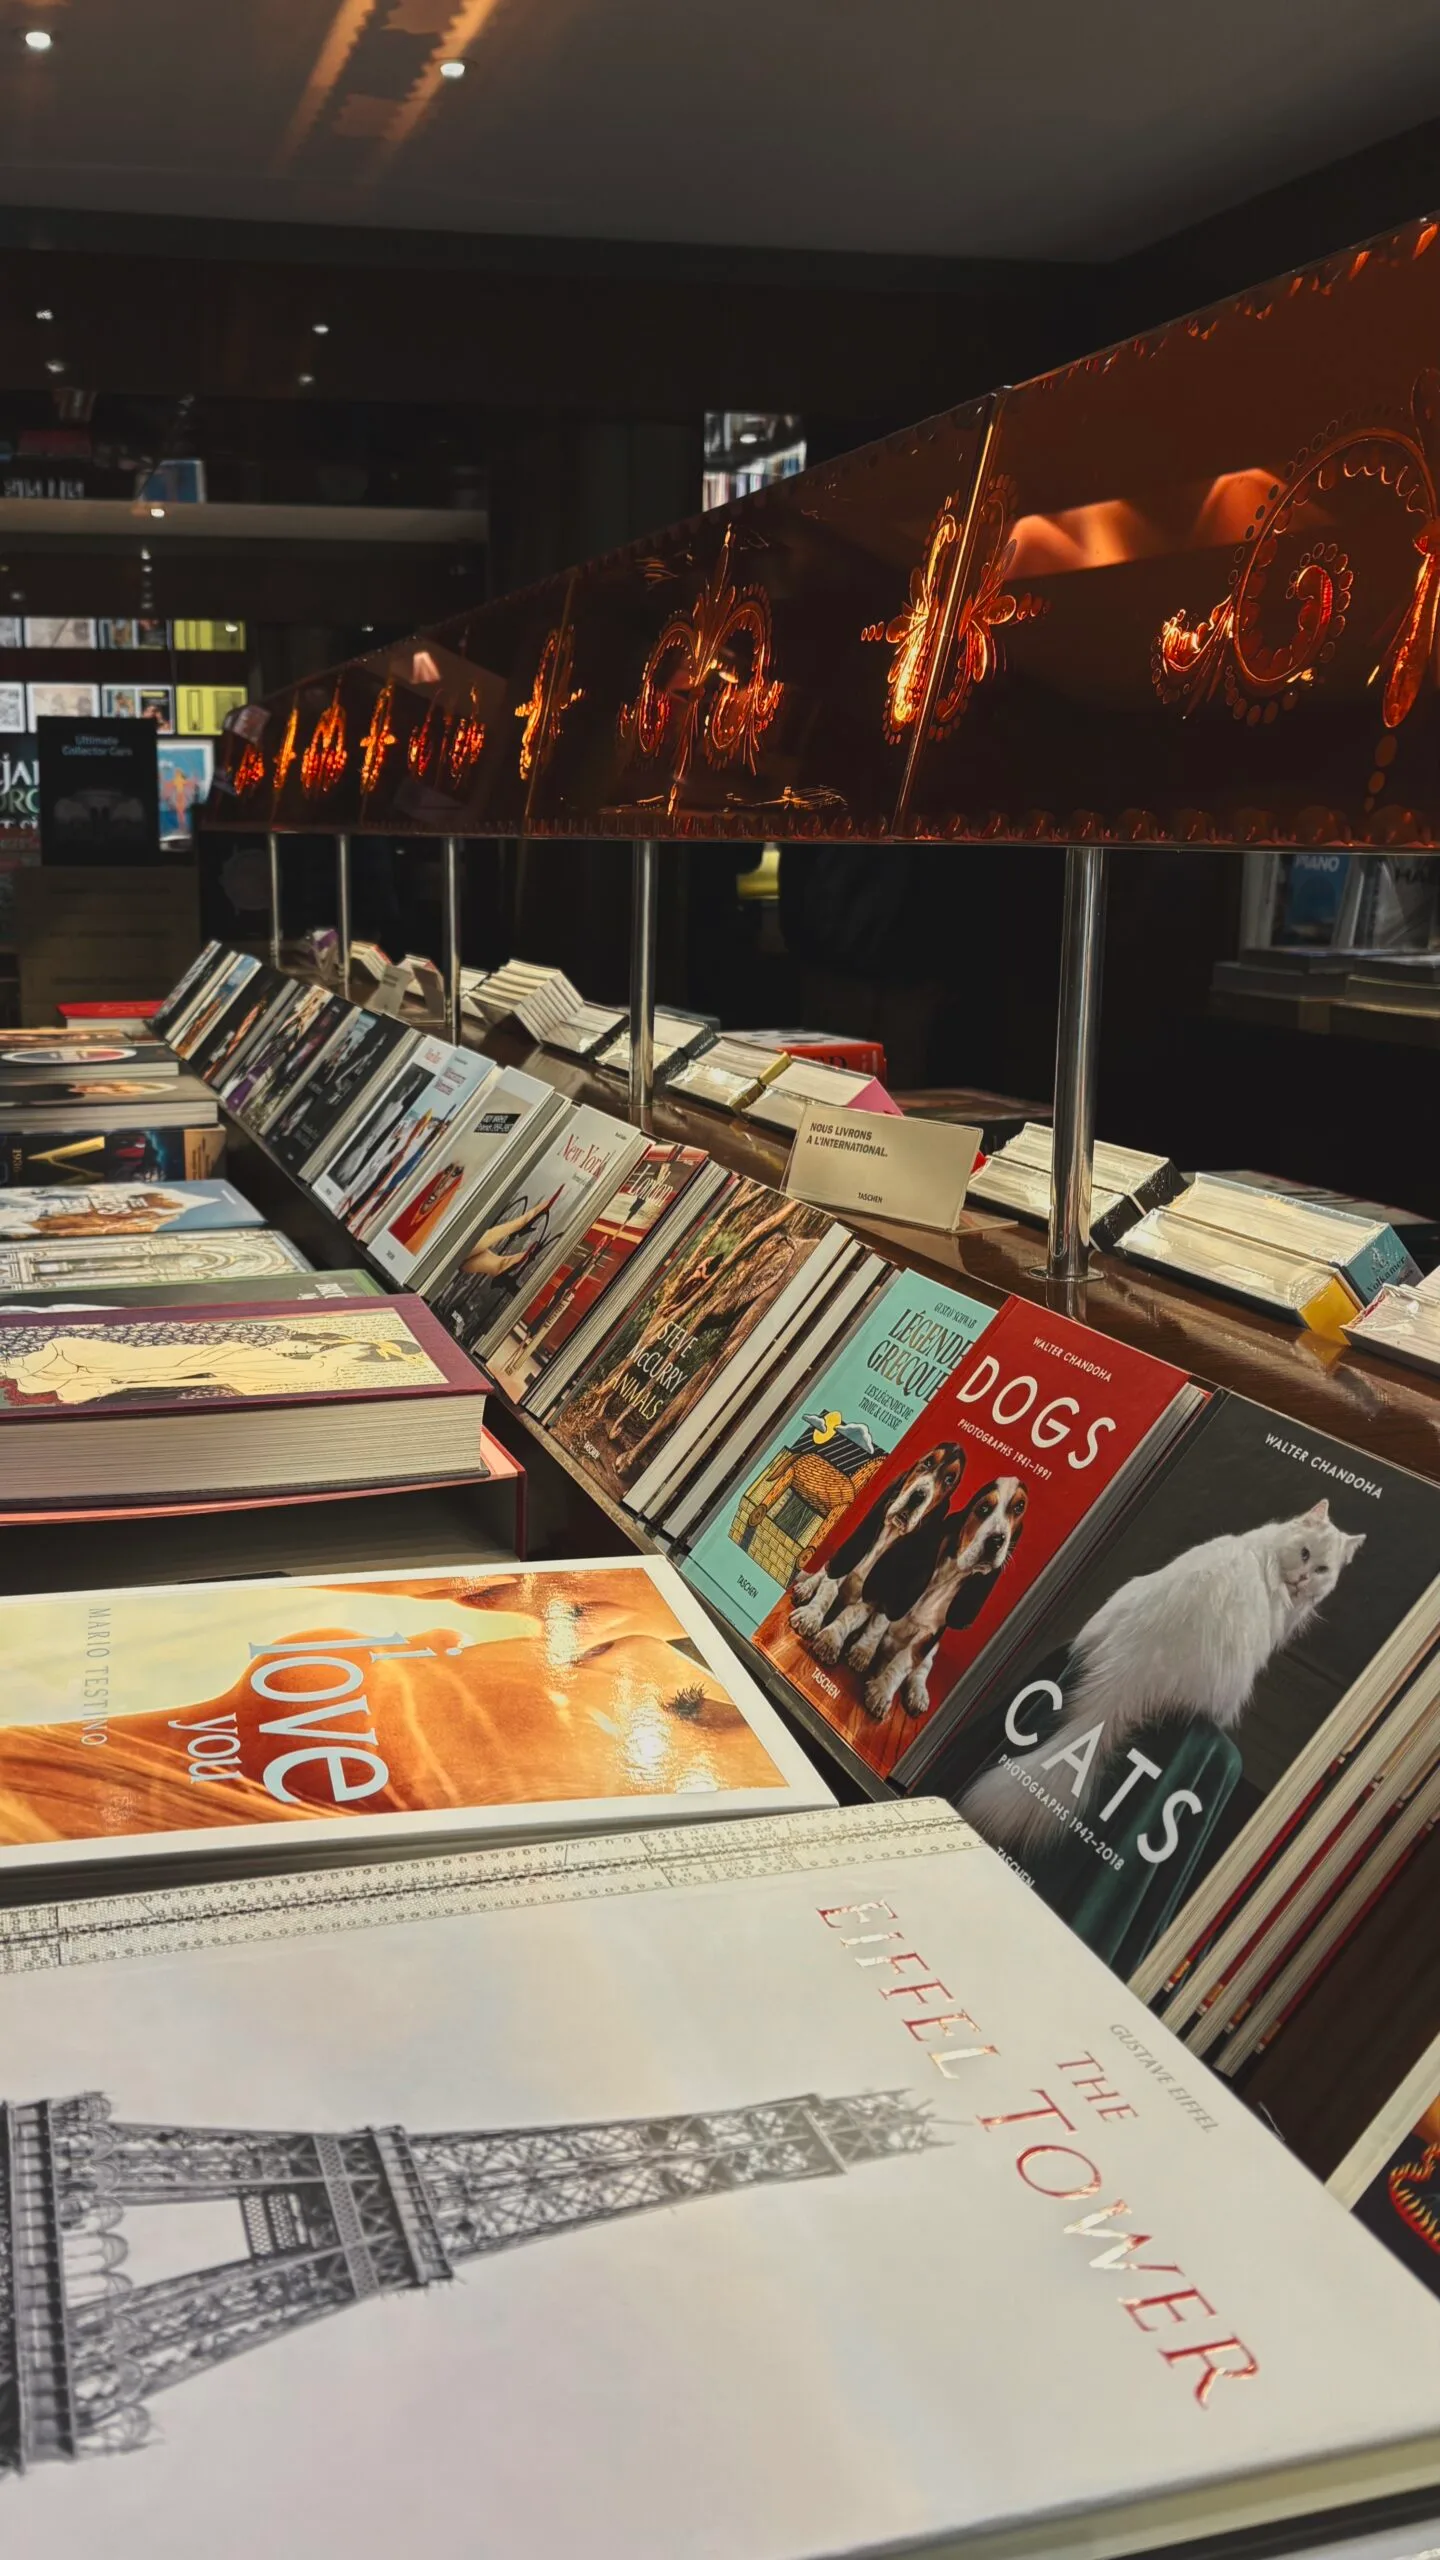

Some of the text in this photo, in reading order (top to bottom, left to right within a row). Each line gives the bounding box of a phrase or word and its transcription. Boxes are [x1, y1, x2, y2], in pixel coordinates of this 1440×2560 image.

[557, 1134, 612, 1179] New York
[809, 1122, 873, 1141] NOUS LIVRONS
[626, 1163, 674, 1208] London
[857, 1192, 883, 1204] TASCHEN
[657, 1321, 699, 1359] STEVE
[888, 1309, 976, 1371] LÉGENDE
[953, 1311, 978, 1329] SCHWAB
[627, 1341, 690, 1392] McCURRY
[867, 1340, 950, 1402] GRECQUE
[1033, 1336, 1113, 1383] WALTER CHANDOHA
[607, 1371, 664, 1421] ANIMALS
[864, 1384, 878, 1400] LES
[901, 1407, 914, 1421] DE
[956, 1355, 1117, 1470] DOGS
[957, 1418, 1014, 1457] PHOTOGRAPHS
[1264, 1432, 1384, 1499] WALTER CHANDOHA
[736, 1573, 759, 1599] TASCHEN
[80, 1606, 112, 1746] MARIO TESTINO
[811, 1666, 841, 1700] TASCHEN
[249, 1631, 410, 1803] love
[167, 1712, 244, 1784] you
[1004, 1679, 1203, 1863] CATS
[998, 1753, 1070, 1822] PHOTOGRAPHS
[995, 1846, 1036, 1888] TASCHEN
[1055, 2050, 1140, 2124] THE
[1109, 2023, 1220, 2135] GUSTAVE EIFFEL
[815, 1899, 1259, 2411] EIFFEL TOWER
